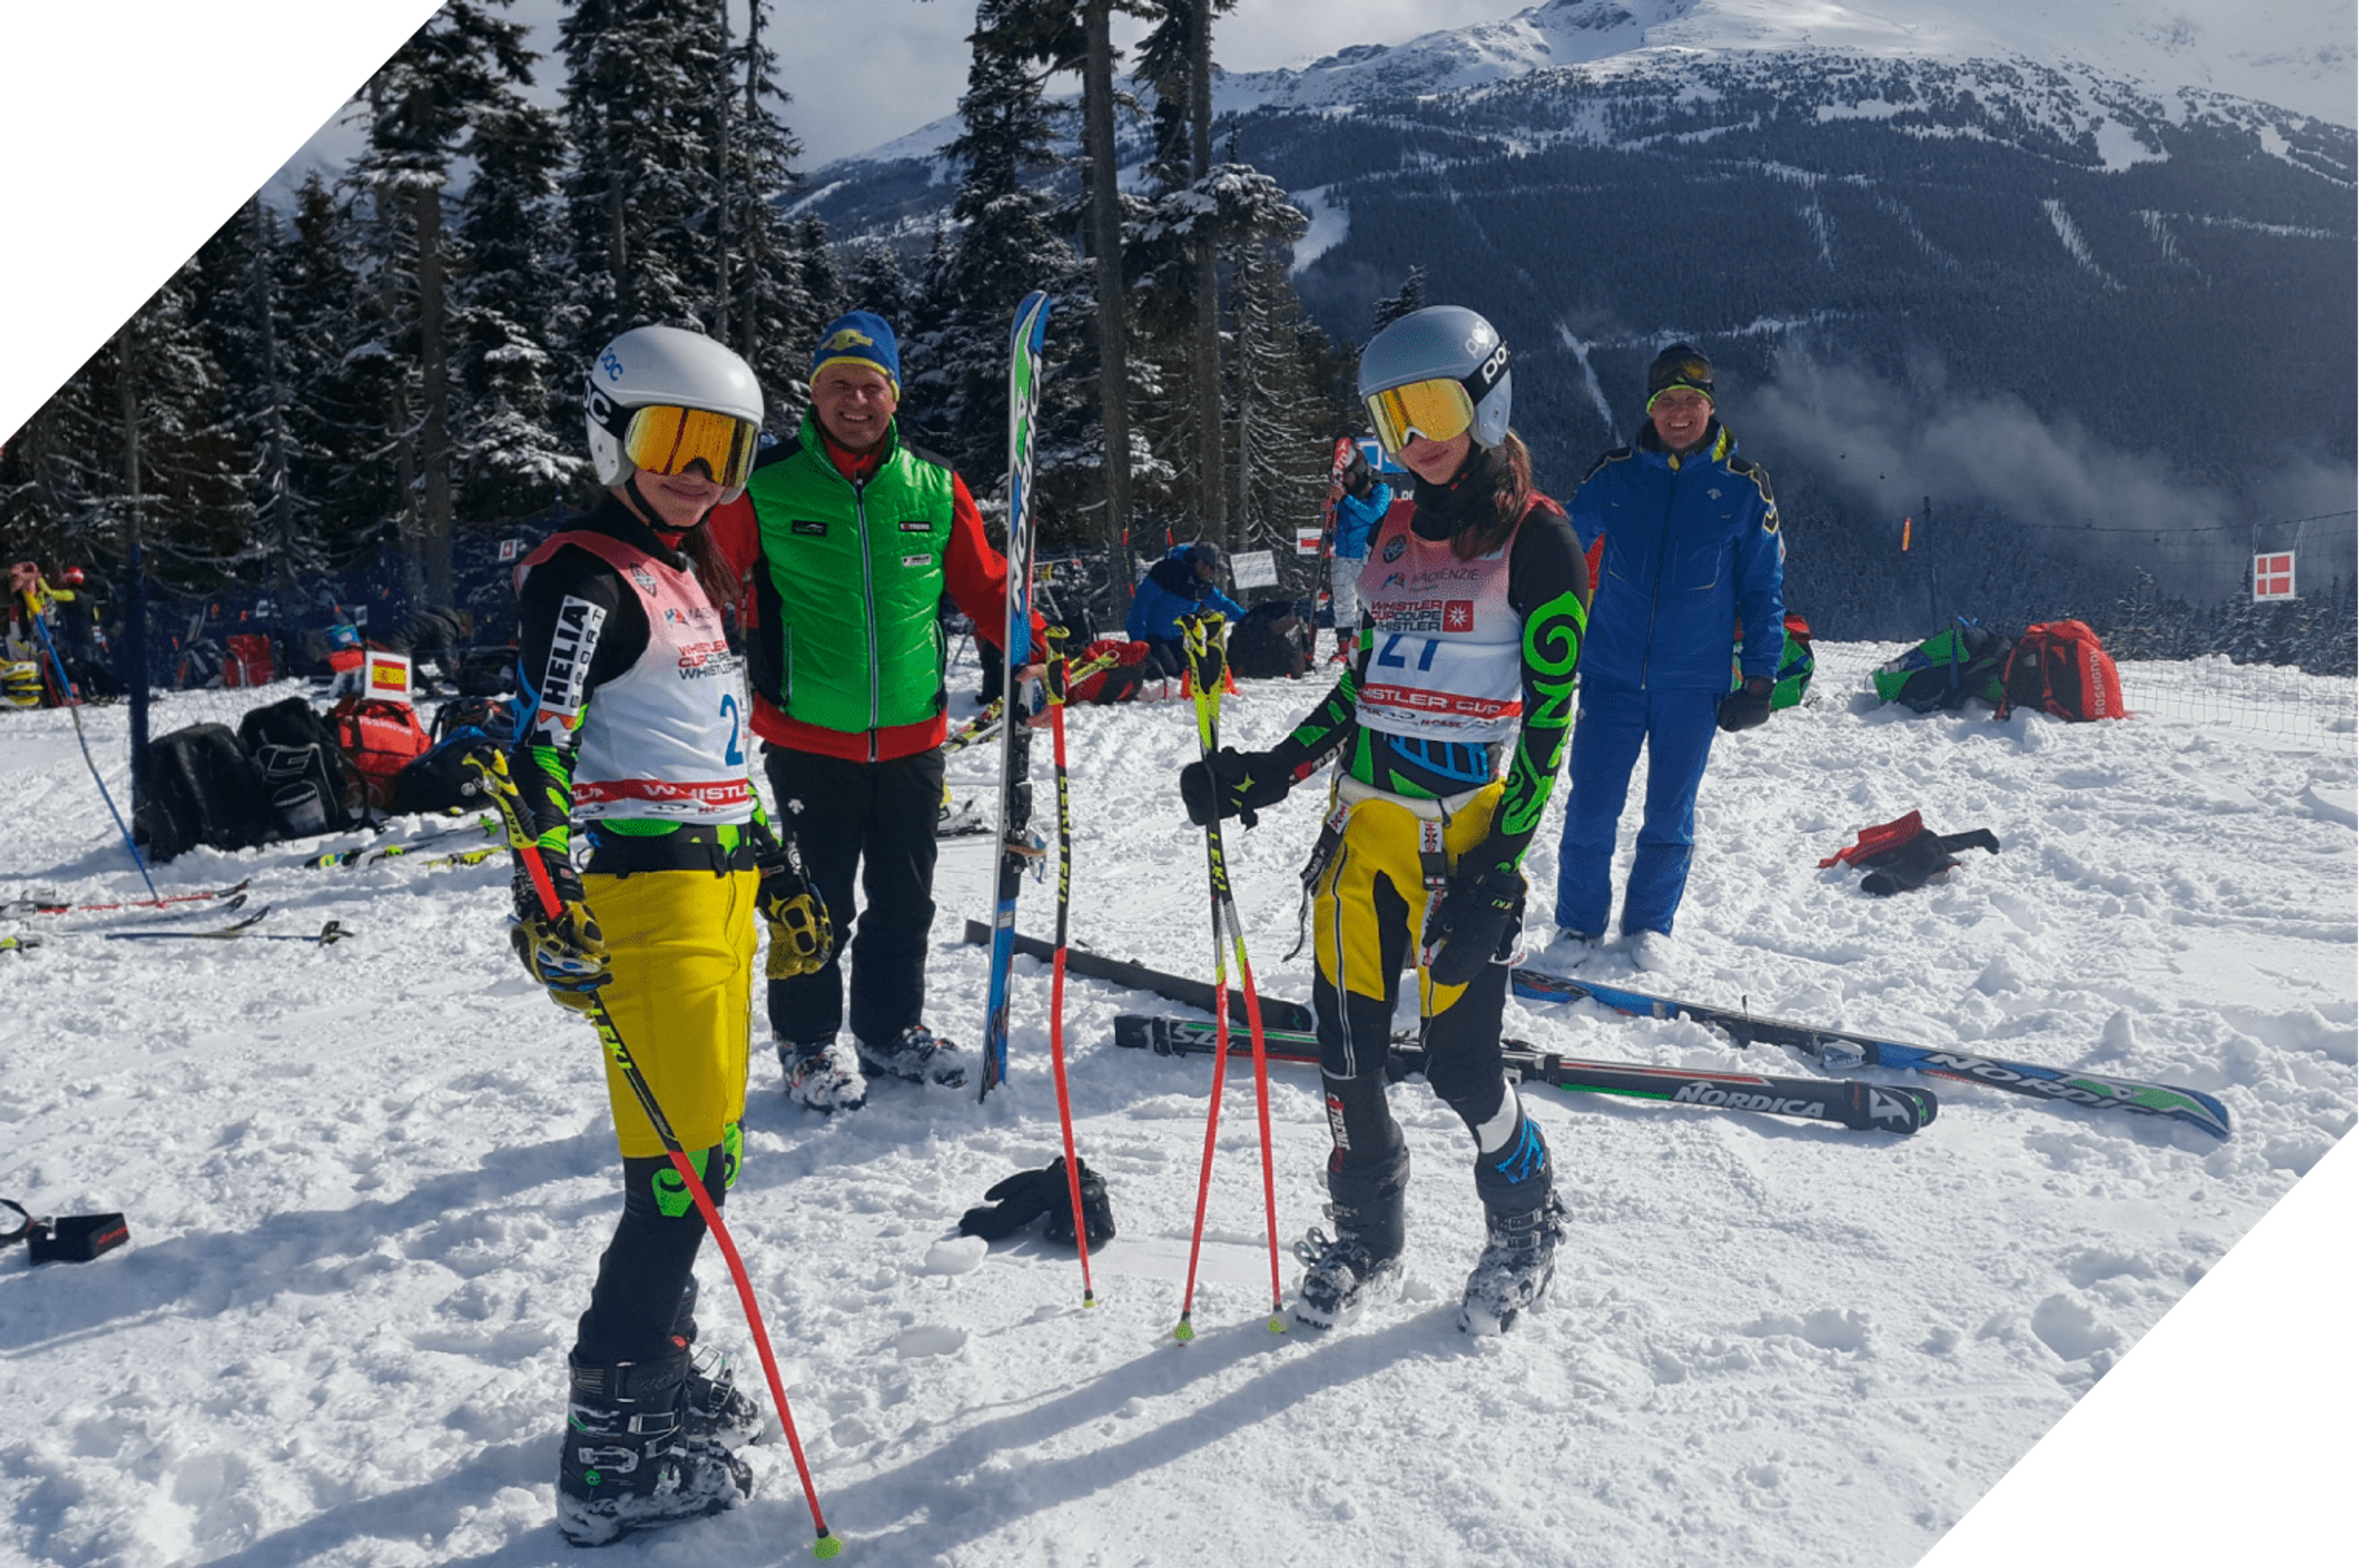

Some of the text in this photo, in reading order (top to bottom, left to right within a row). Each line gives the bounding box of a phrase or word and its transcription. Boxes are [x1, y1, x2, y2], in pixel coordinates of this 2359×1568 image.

[1012, 352, 1043, 616] NORDICA
[541, 605, 591, 706] HELIA
[569, 608, 603, 709] SPORT
[1357, 688, 1501, 714] HISTLER CUP
[1673, 1080, 1826, 1119] NORDICA
